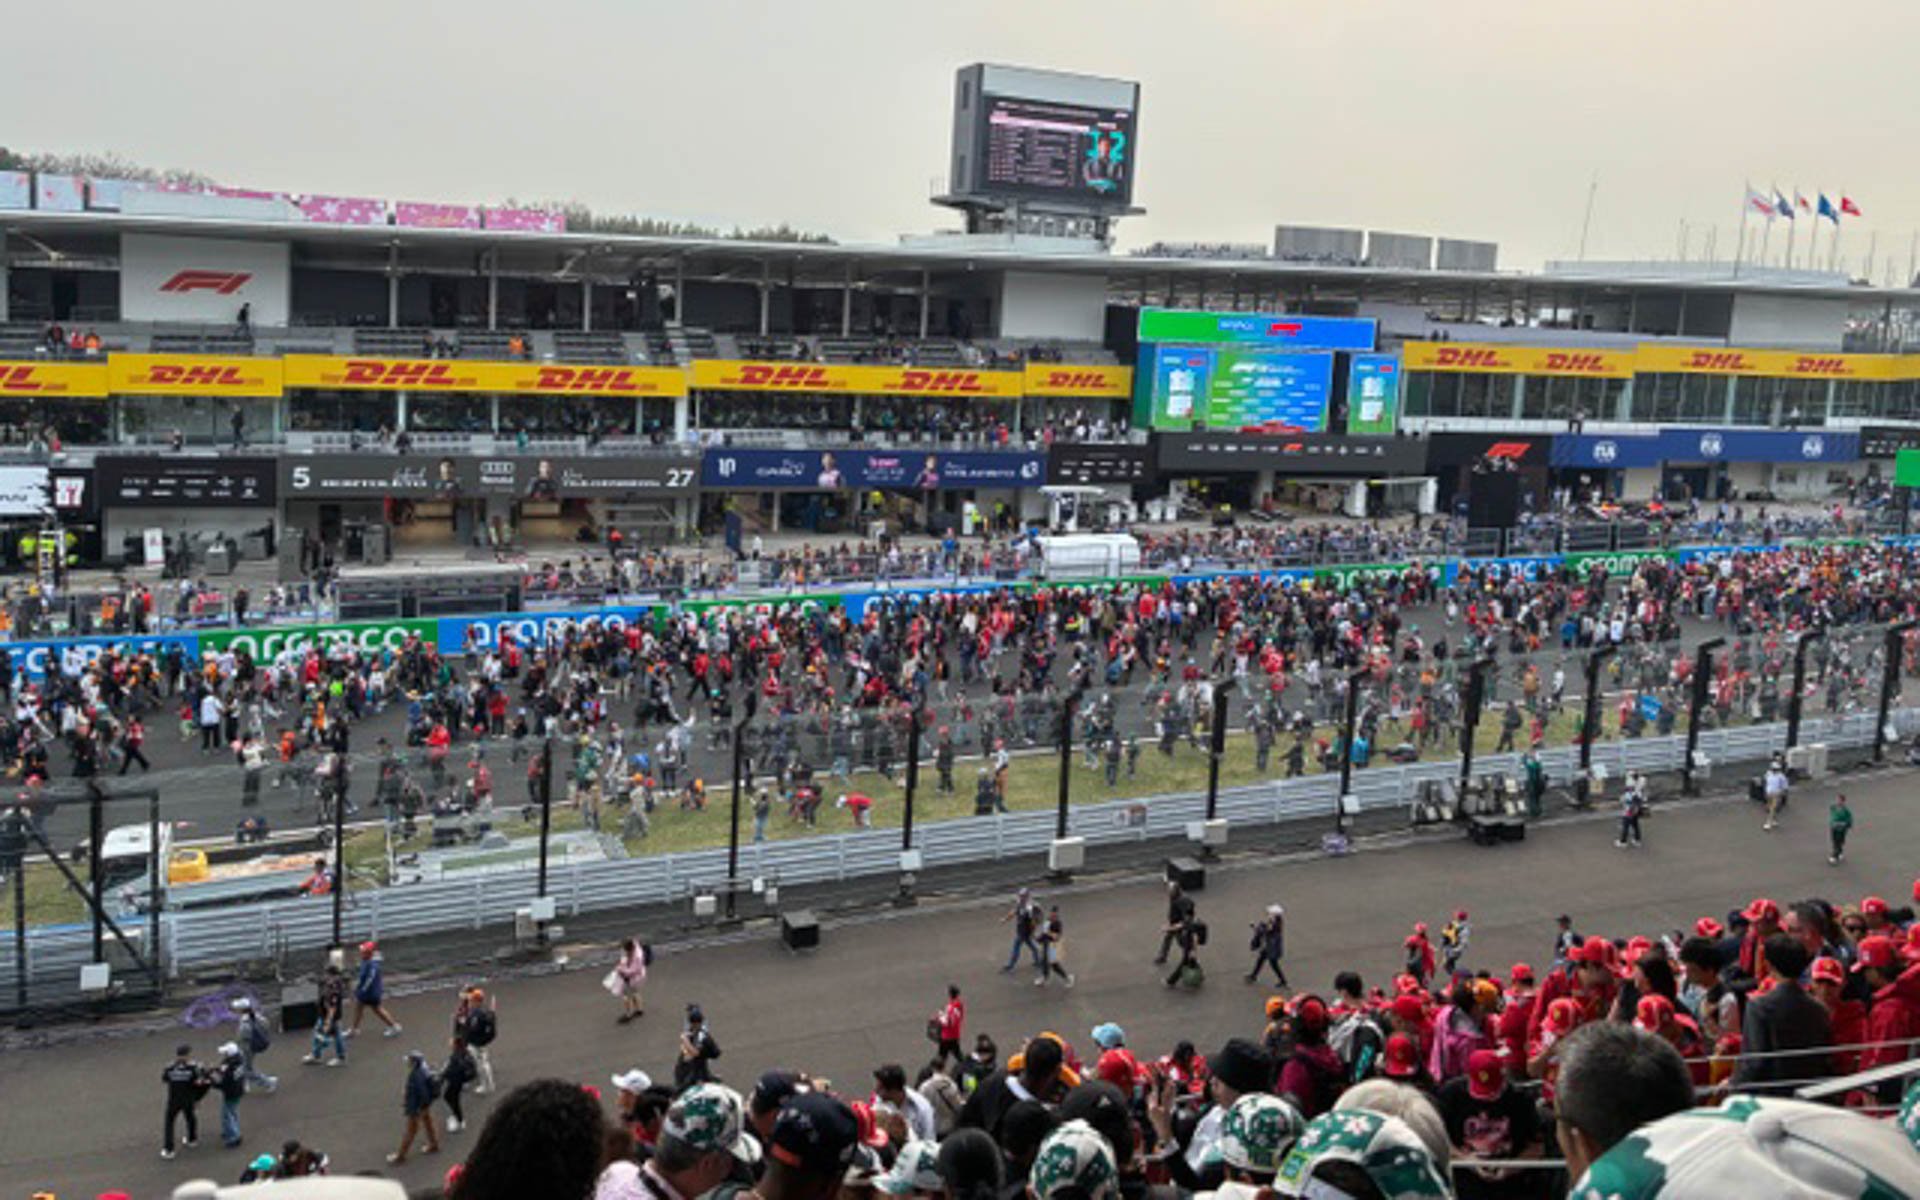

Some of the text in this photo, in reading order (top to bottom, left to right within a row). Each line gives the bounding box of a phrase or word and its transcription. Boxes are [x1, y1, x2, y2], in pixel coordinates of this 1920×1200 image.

[1436, 348, 1500, 367] DHL
[1546, 353, 1604, 372] DHL
[1691, 353, 1746, 371] DHL
[1795, 357, 1848, 374] DHL
[149, 366, 245, 385] DHL
[341, 360, 456, 384] DHL
[536, 367, 637, 390] DHL
[736, 366, 830, 388] DHL
[900, 371, 982, 391] DHL
[1048, 372, 1106, 388] DHL
[293, 467, 310, 488] 5
[665, 469, 694, 487] 27
